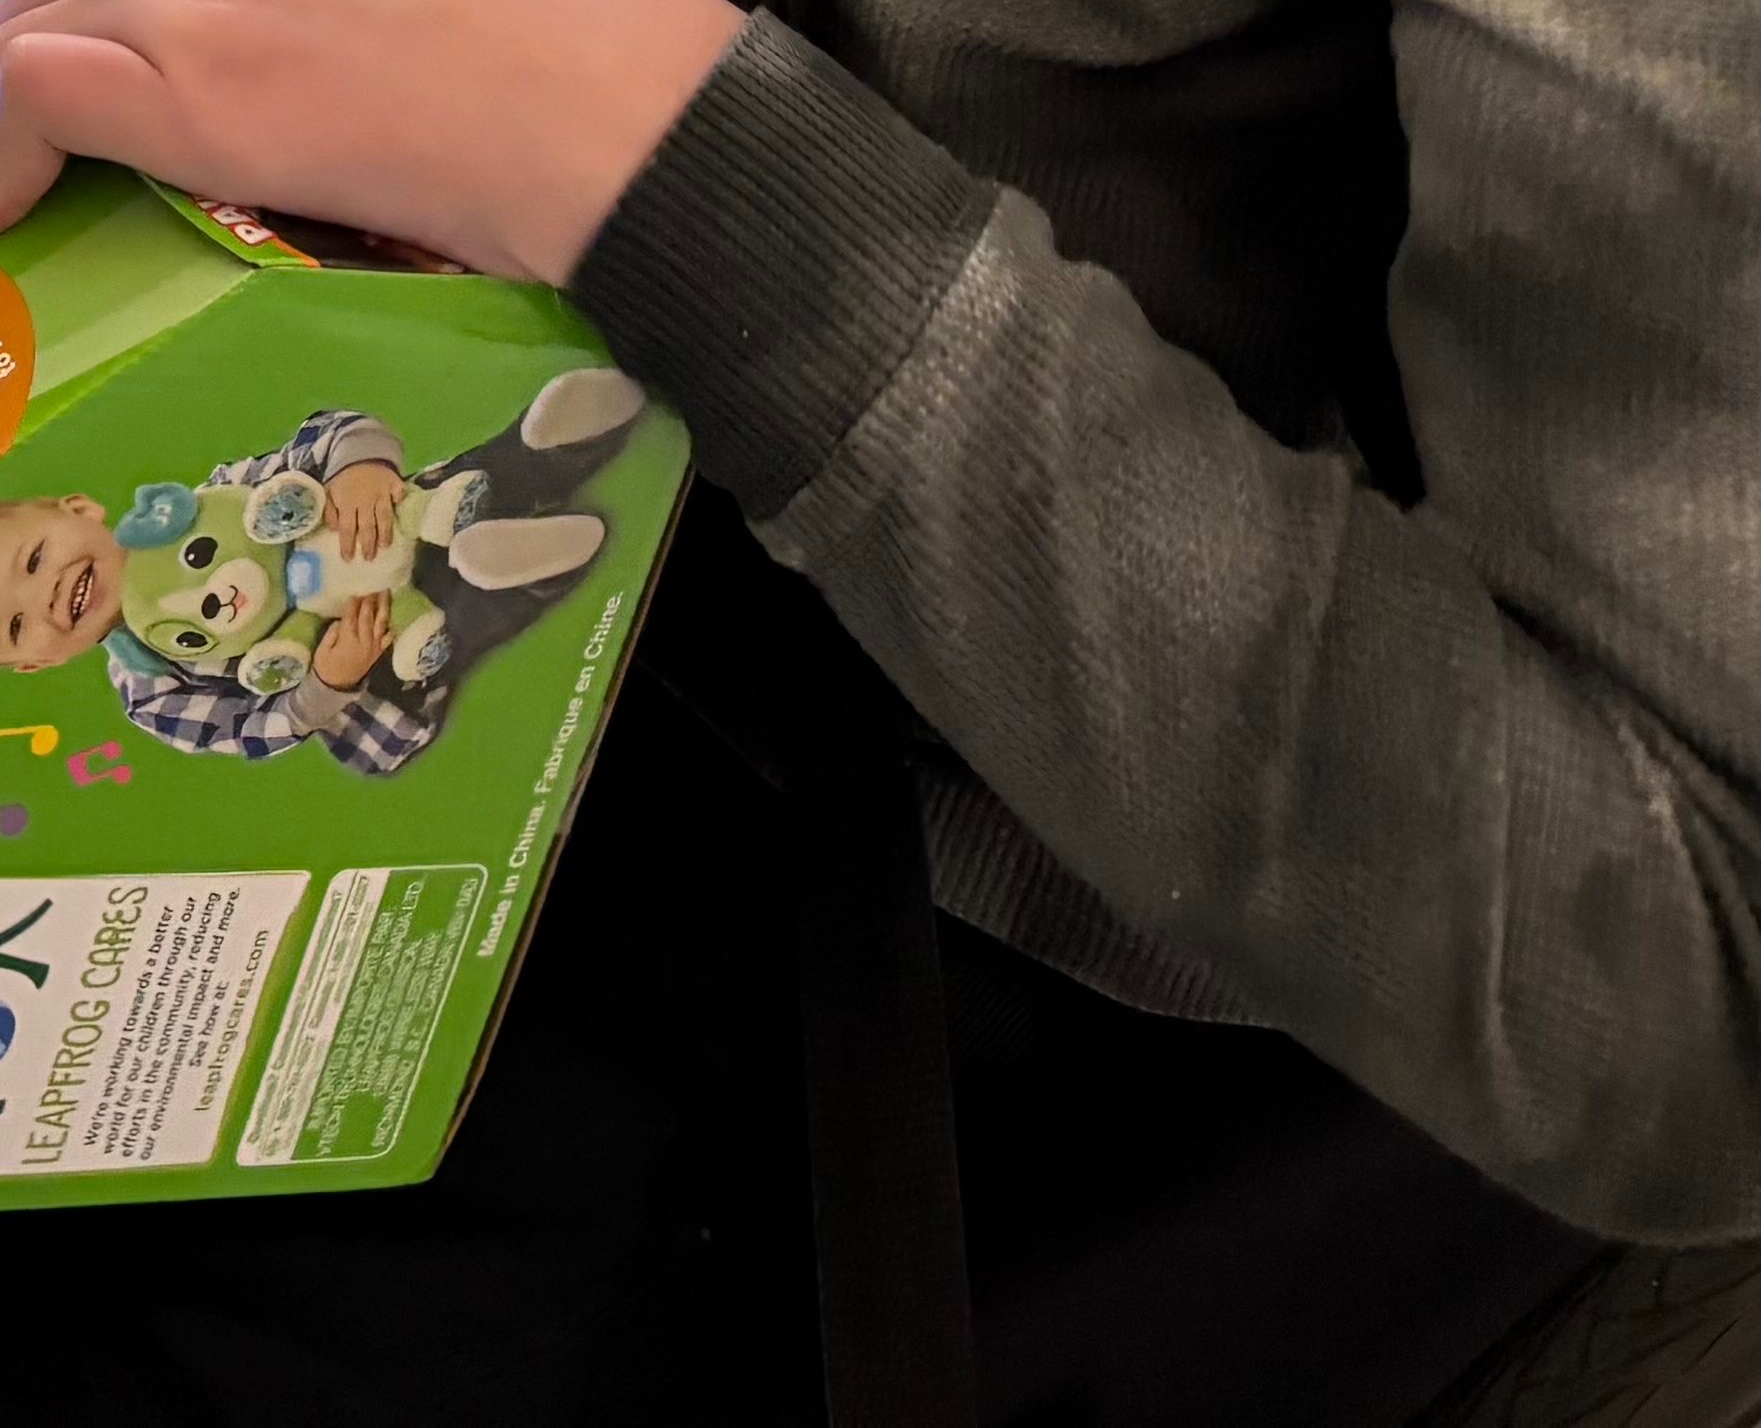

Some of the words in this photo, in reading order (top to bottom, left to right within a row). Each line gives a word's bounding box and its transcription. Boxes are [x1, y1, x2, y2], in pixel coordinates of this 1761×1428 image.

[583, 590, 624, 661] Chine.
[574, 664, 596, 694] en
[507, 799, 547, 870] China.
[498, 874, 521, 896] in
[189, 891, 223, 963] reducing
[476, 897, 513, 958] Made
[21, 999, 112, 1165] LEAPFROG
[80, 885, 149, 990] CARES
[84, 1101, 111, 1147] We're
[104, 1034, 133, 1099] working
[122, 969, 153, 1035] towards
[148, 906, 175, 956] better
[103, 1112, 126, 1156] world
[118, 1085, 134, 1112] for
[128, 1058, 144, 1084] our
[138, 990, 167, 1054] children
[158, 924, 188, 989] through
[181, 896, 198, 924] our
[157, 965, 198, 1057] community,
[192, 929, 270, 1113] leapfrogcares.com
[203, 1008, 220, 1038] how
[140, 1135, 157, 1162] our
[151, 1023, 194, 1133] environmental
[189, 967, 215, 1023] impact
[210, 934, 227, 966] and
[146, 1058, 164, 1084] the
[141, 1085, 153, 1104] in
[122, 1107, 148, 1158] efforts
